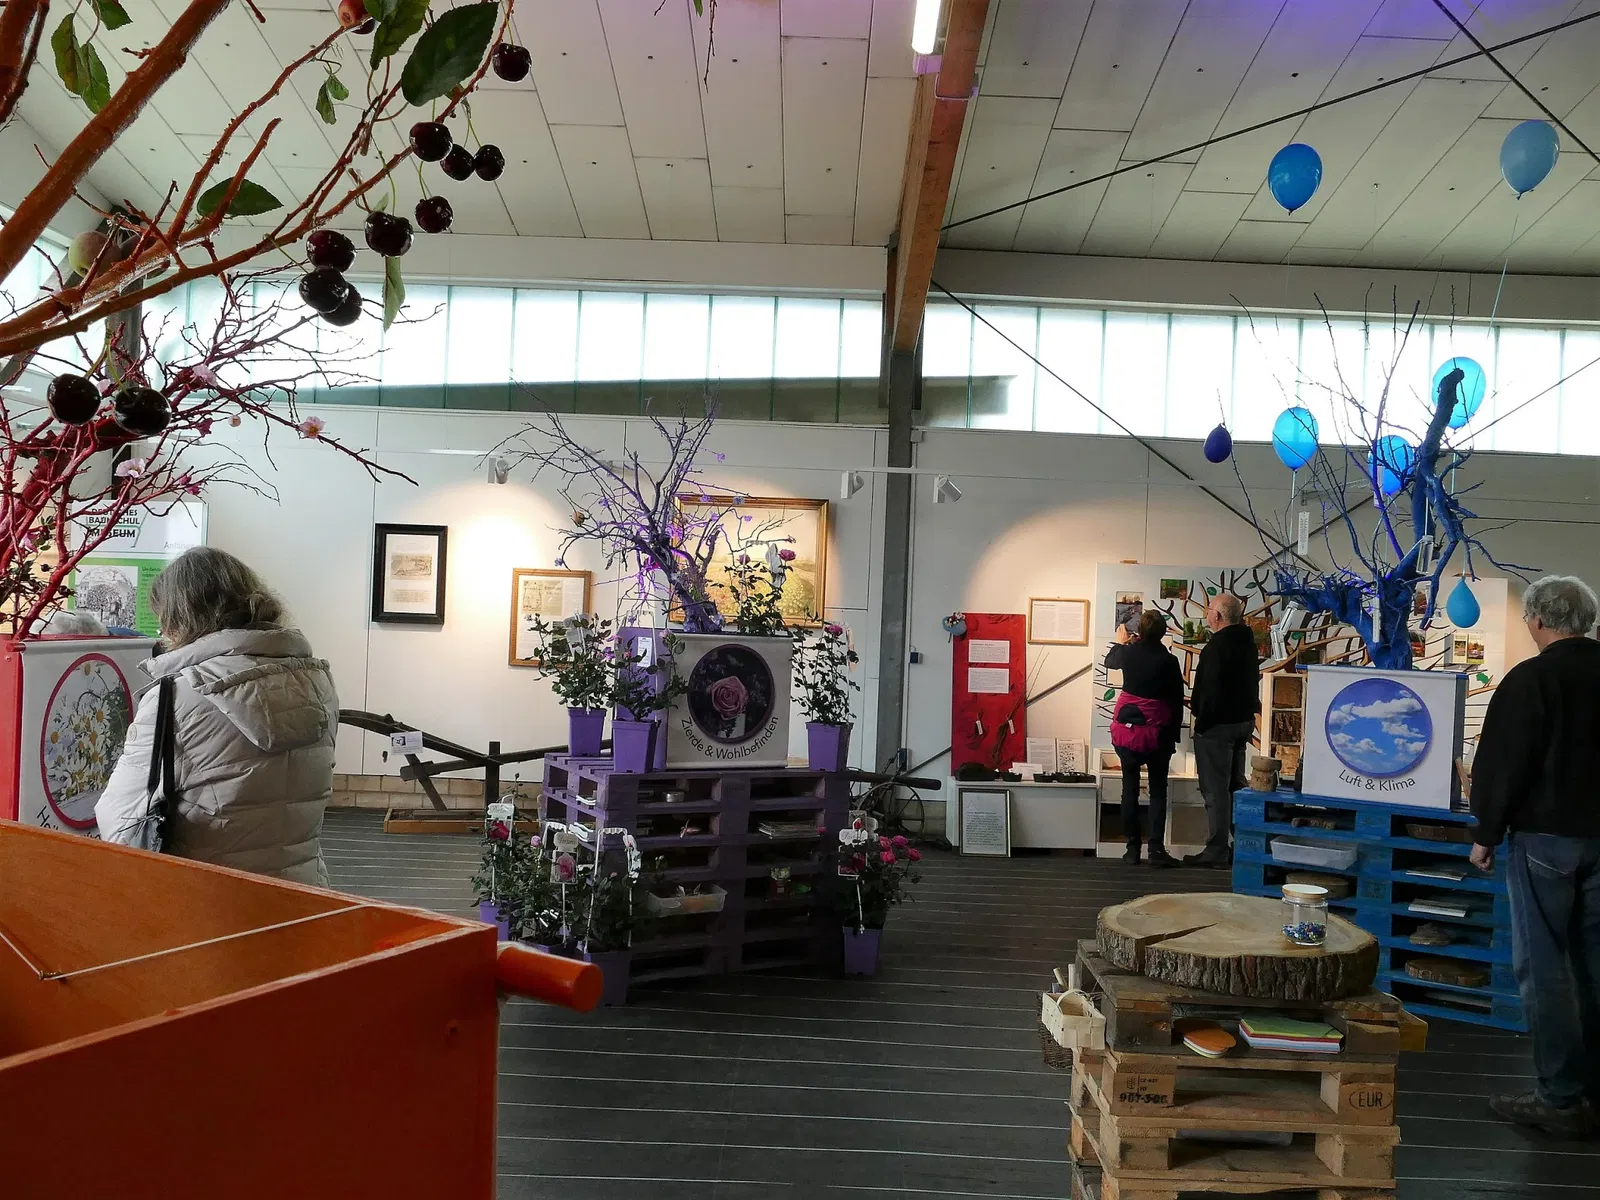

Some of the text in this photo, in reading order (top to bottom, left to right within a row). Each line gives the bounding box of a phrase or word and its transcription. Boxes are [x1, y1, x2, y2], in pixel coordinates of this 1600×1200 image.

[681, 716, 778, 759] Zierde & Wohlbefinden
[1339, 769, 1415, 791] Luft & Klima
[1358, 1091, 1383, 1107] EUR
